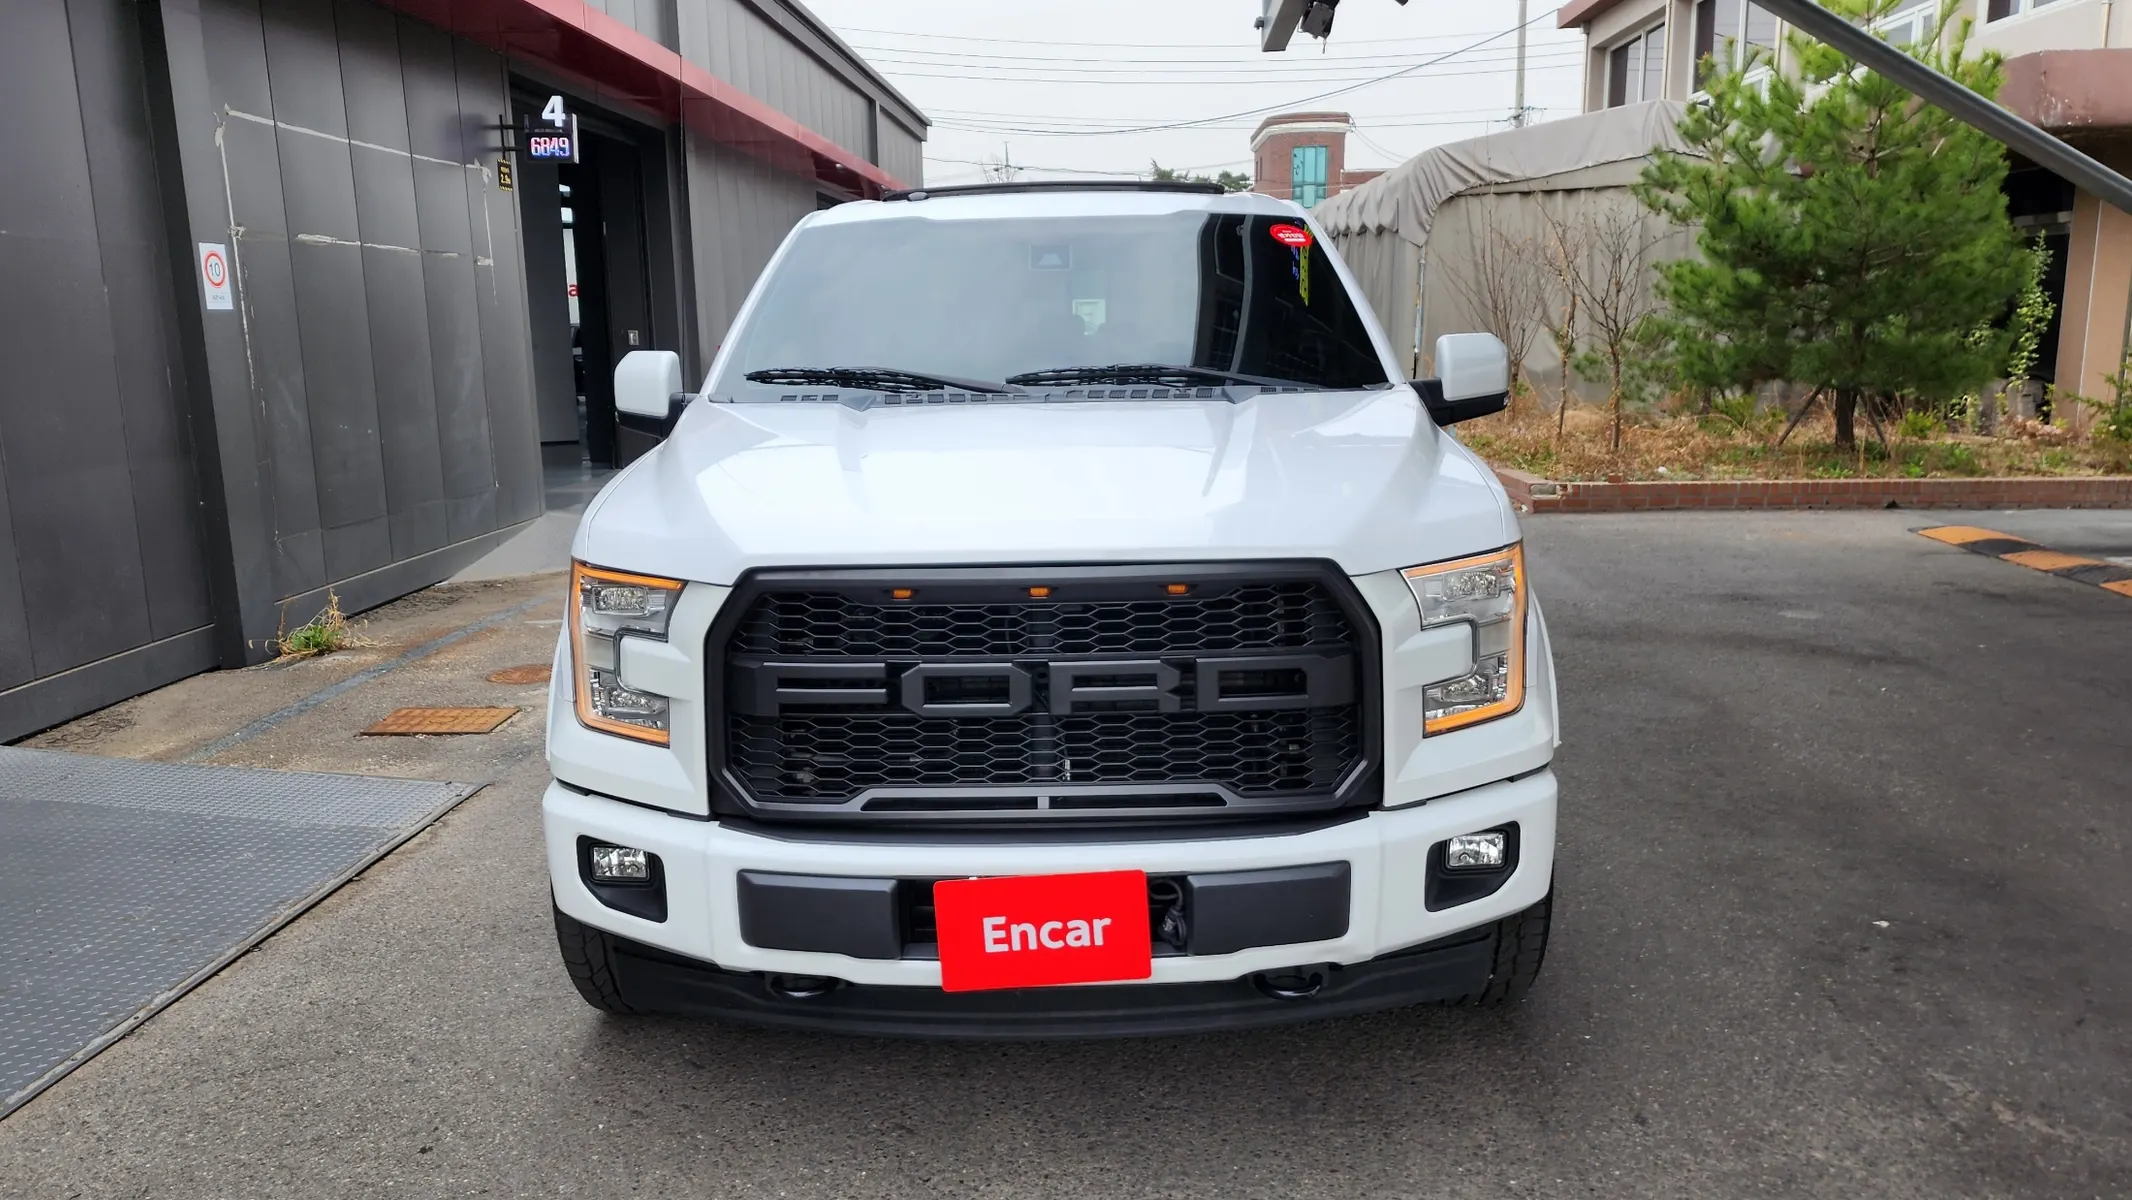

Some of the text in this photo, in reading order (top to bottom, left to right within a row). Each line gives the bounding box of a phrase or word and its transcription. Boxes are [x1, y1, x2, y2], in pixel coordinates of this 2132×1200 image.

[542, 95, 566, 127] 4
[530, 137, 570, 156] 6849
[209, 263, 221, 277] 10
[757, 655, 1346, 718] FORD
[982, 915, 1112, 953] Encar
